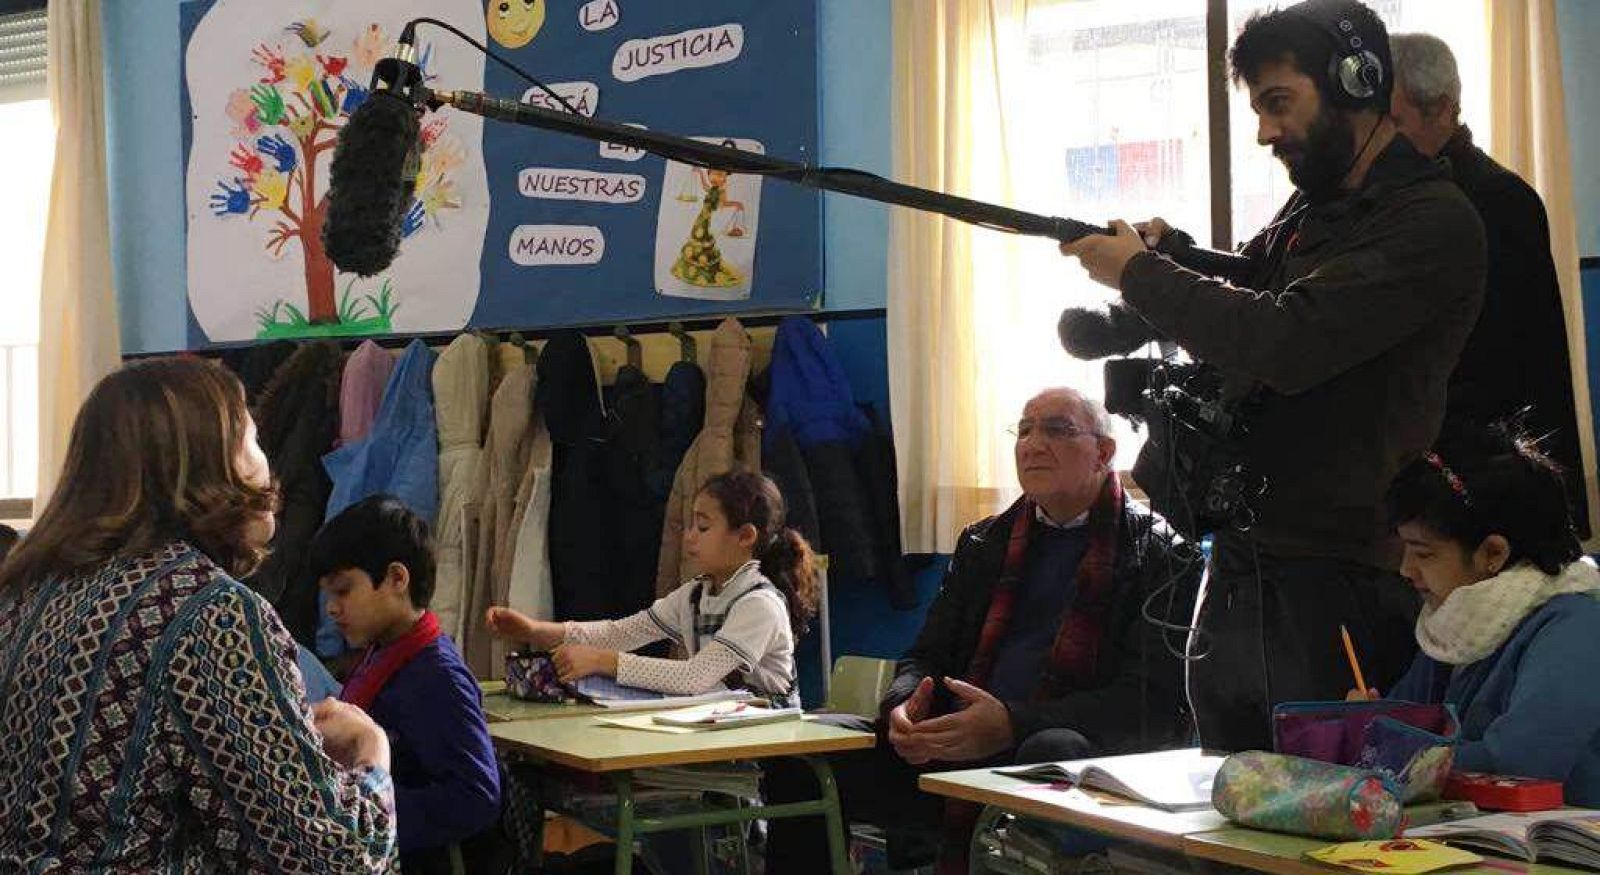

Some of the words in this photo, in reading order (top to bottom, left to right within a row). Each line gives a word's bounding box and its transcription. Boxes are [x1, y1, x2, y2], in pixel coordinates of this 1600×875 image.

[583, 1, 617, 26] LA
[620, 29, 735, 71] JUSTICIA
[523, 174, 640, 198] NUESTRAS
[516, 236, 596, 257] MANOS
